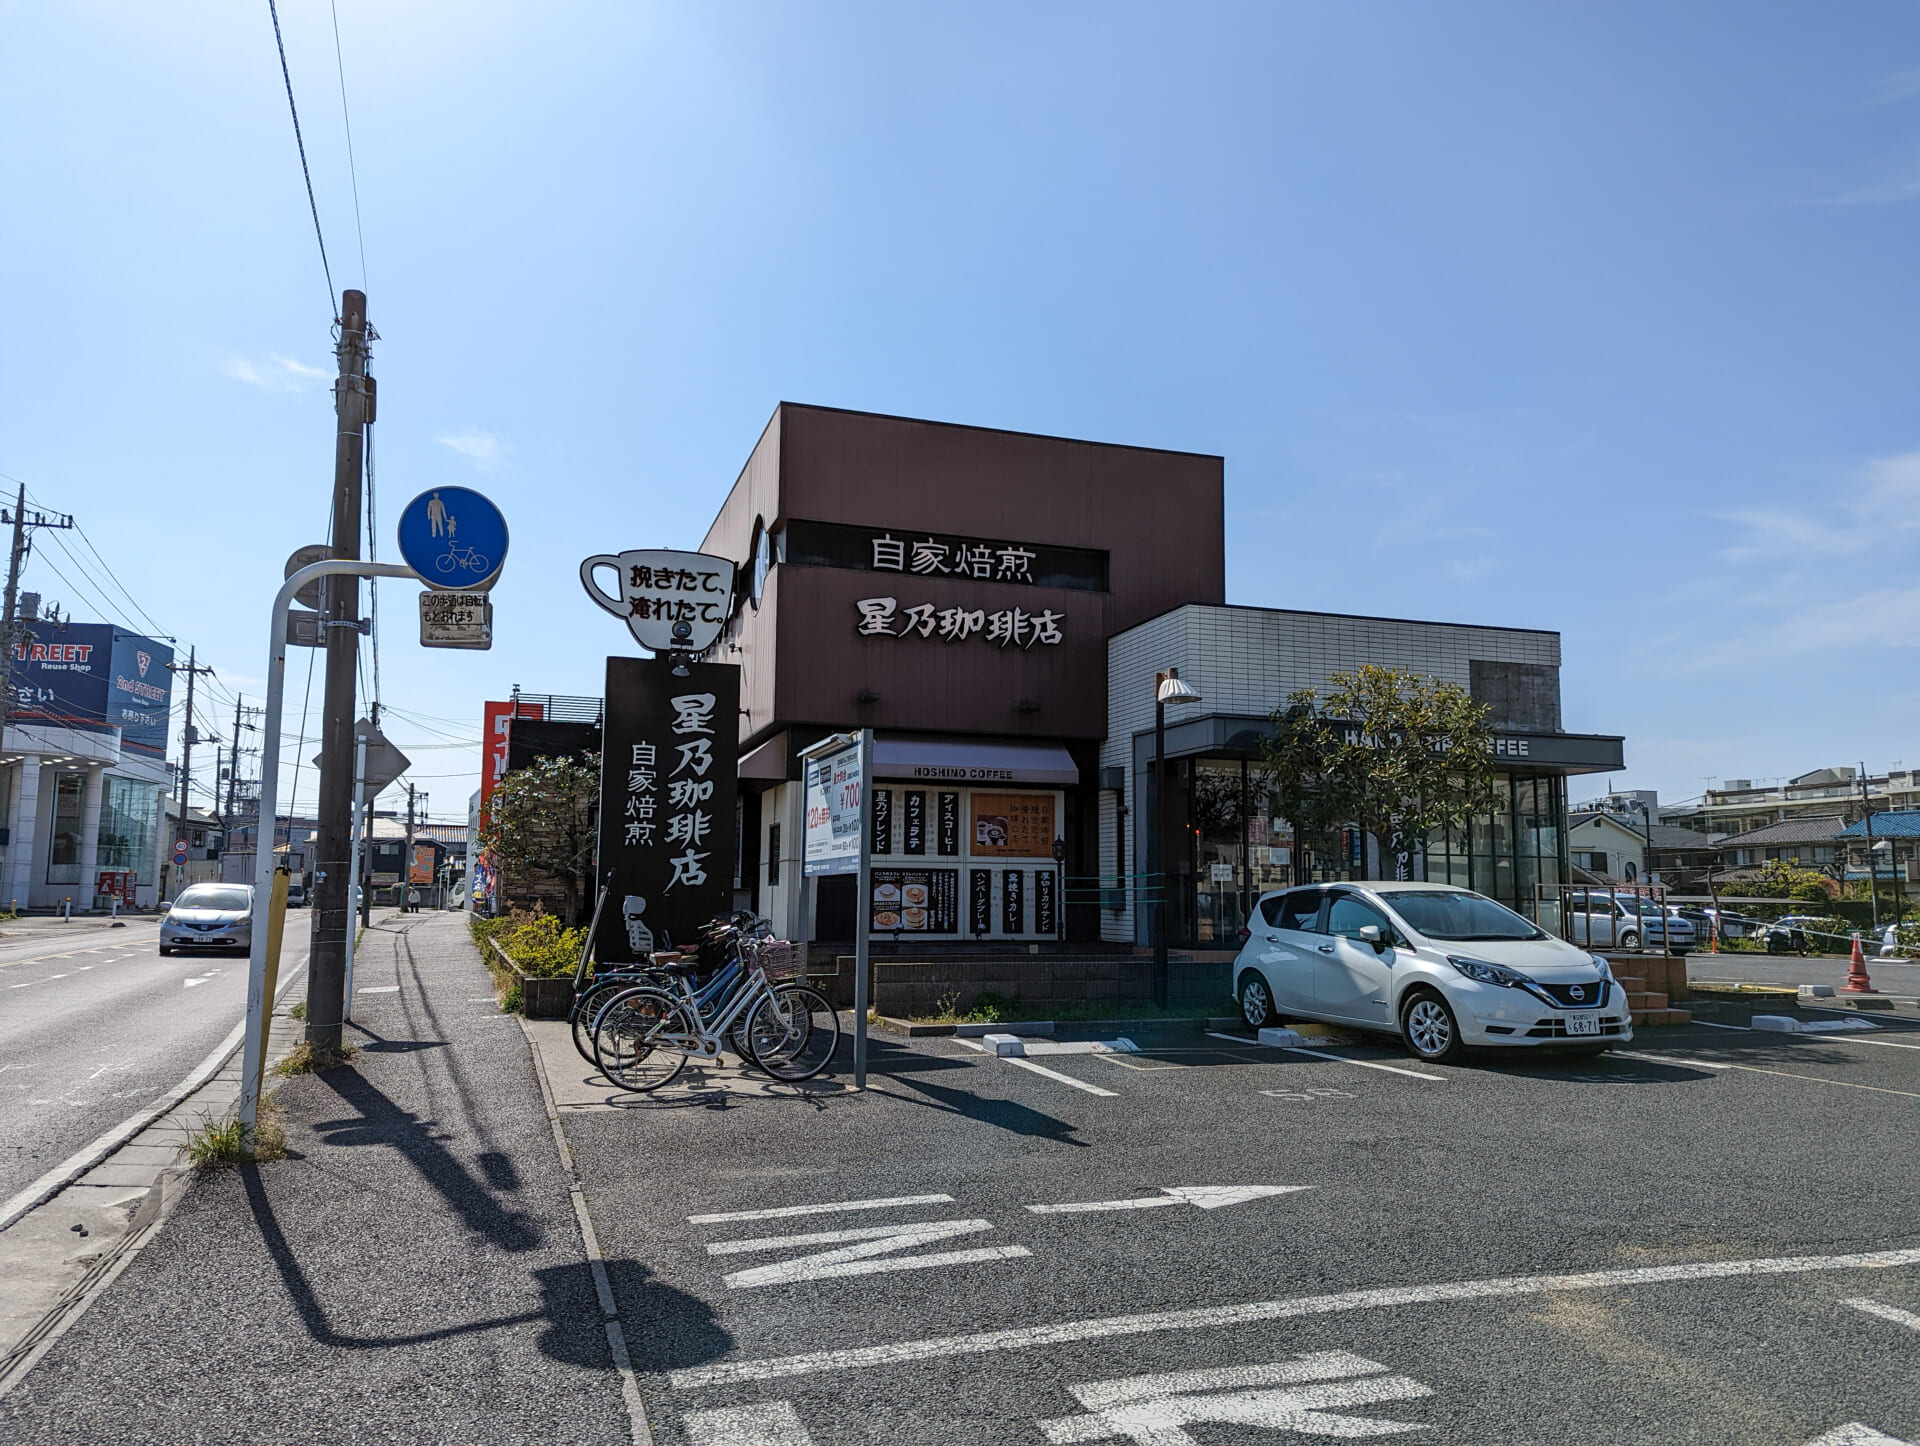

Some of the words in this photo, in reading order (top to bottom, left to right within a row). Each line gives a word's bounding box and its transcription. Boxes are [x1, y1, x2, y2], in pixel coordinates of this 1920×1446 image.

[872, 534, 1037, 583] 自家焙煎
[856, 597, 1066, 650] 星乃珈琲店
[10, 643, 93, 662] TREET
[41, 662, 67, 671] Reuse
[70, 664, 91, 672] Shop
[117, 675, 134, 692] 2nd
[135, 682, 165, 702] STREET
[624, 740, 658, 848] 自家焙煎
[663, 692, 717, 895] 星乃珈琲店
[914, 767, 967, 779] HOSHINO
[970, 768, 1014, 780] COFFEE
[875, 791, 888, 853] 星乃ブレンド
[909, 795, 921, 848] カフェラテ
[943, 794, 955, 852] アイスコーヒー
